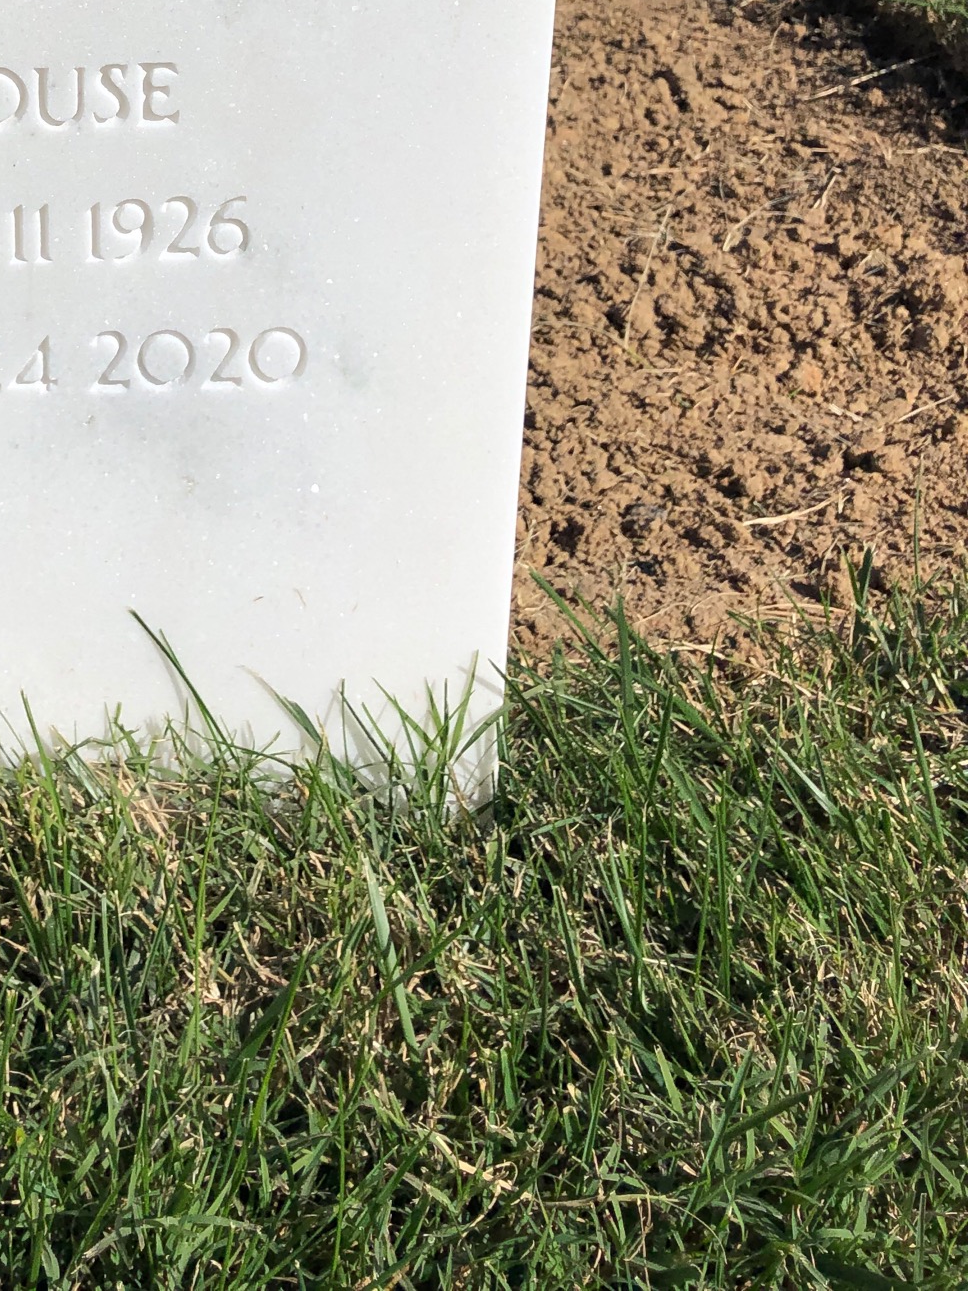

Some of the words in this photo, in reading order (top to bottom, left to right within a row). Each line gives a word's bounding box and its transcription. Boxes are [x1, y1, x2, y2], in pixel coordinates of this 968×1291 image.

[9, 203, 52, 263] 11
[87, 195, 253, 263] 1926
[93, 326, 309, 392] 2020
